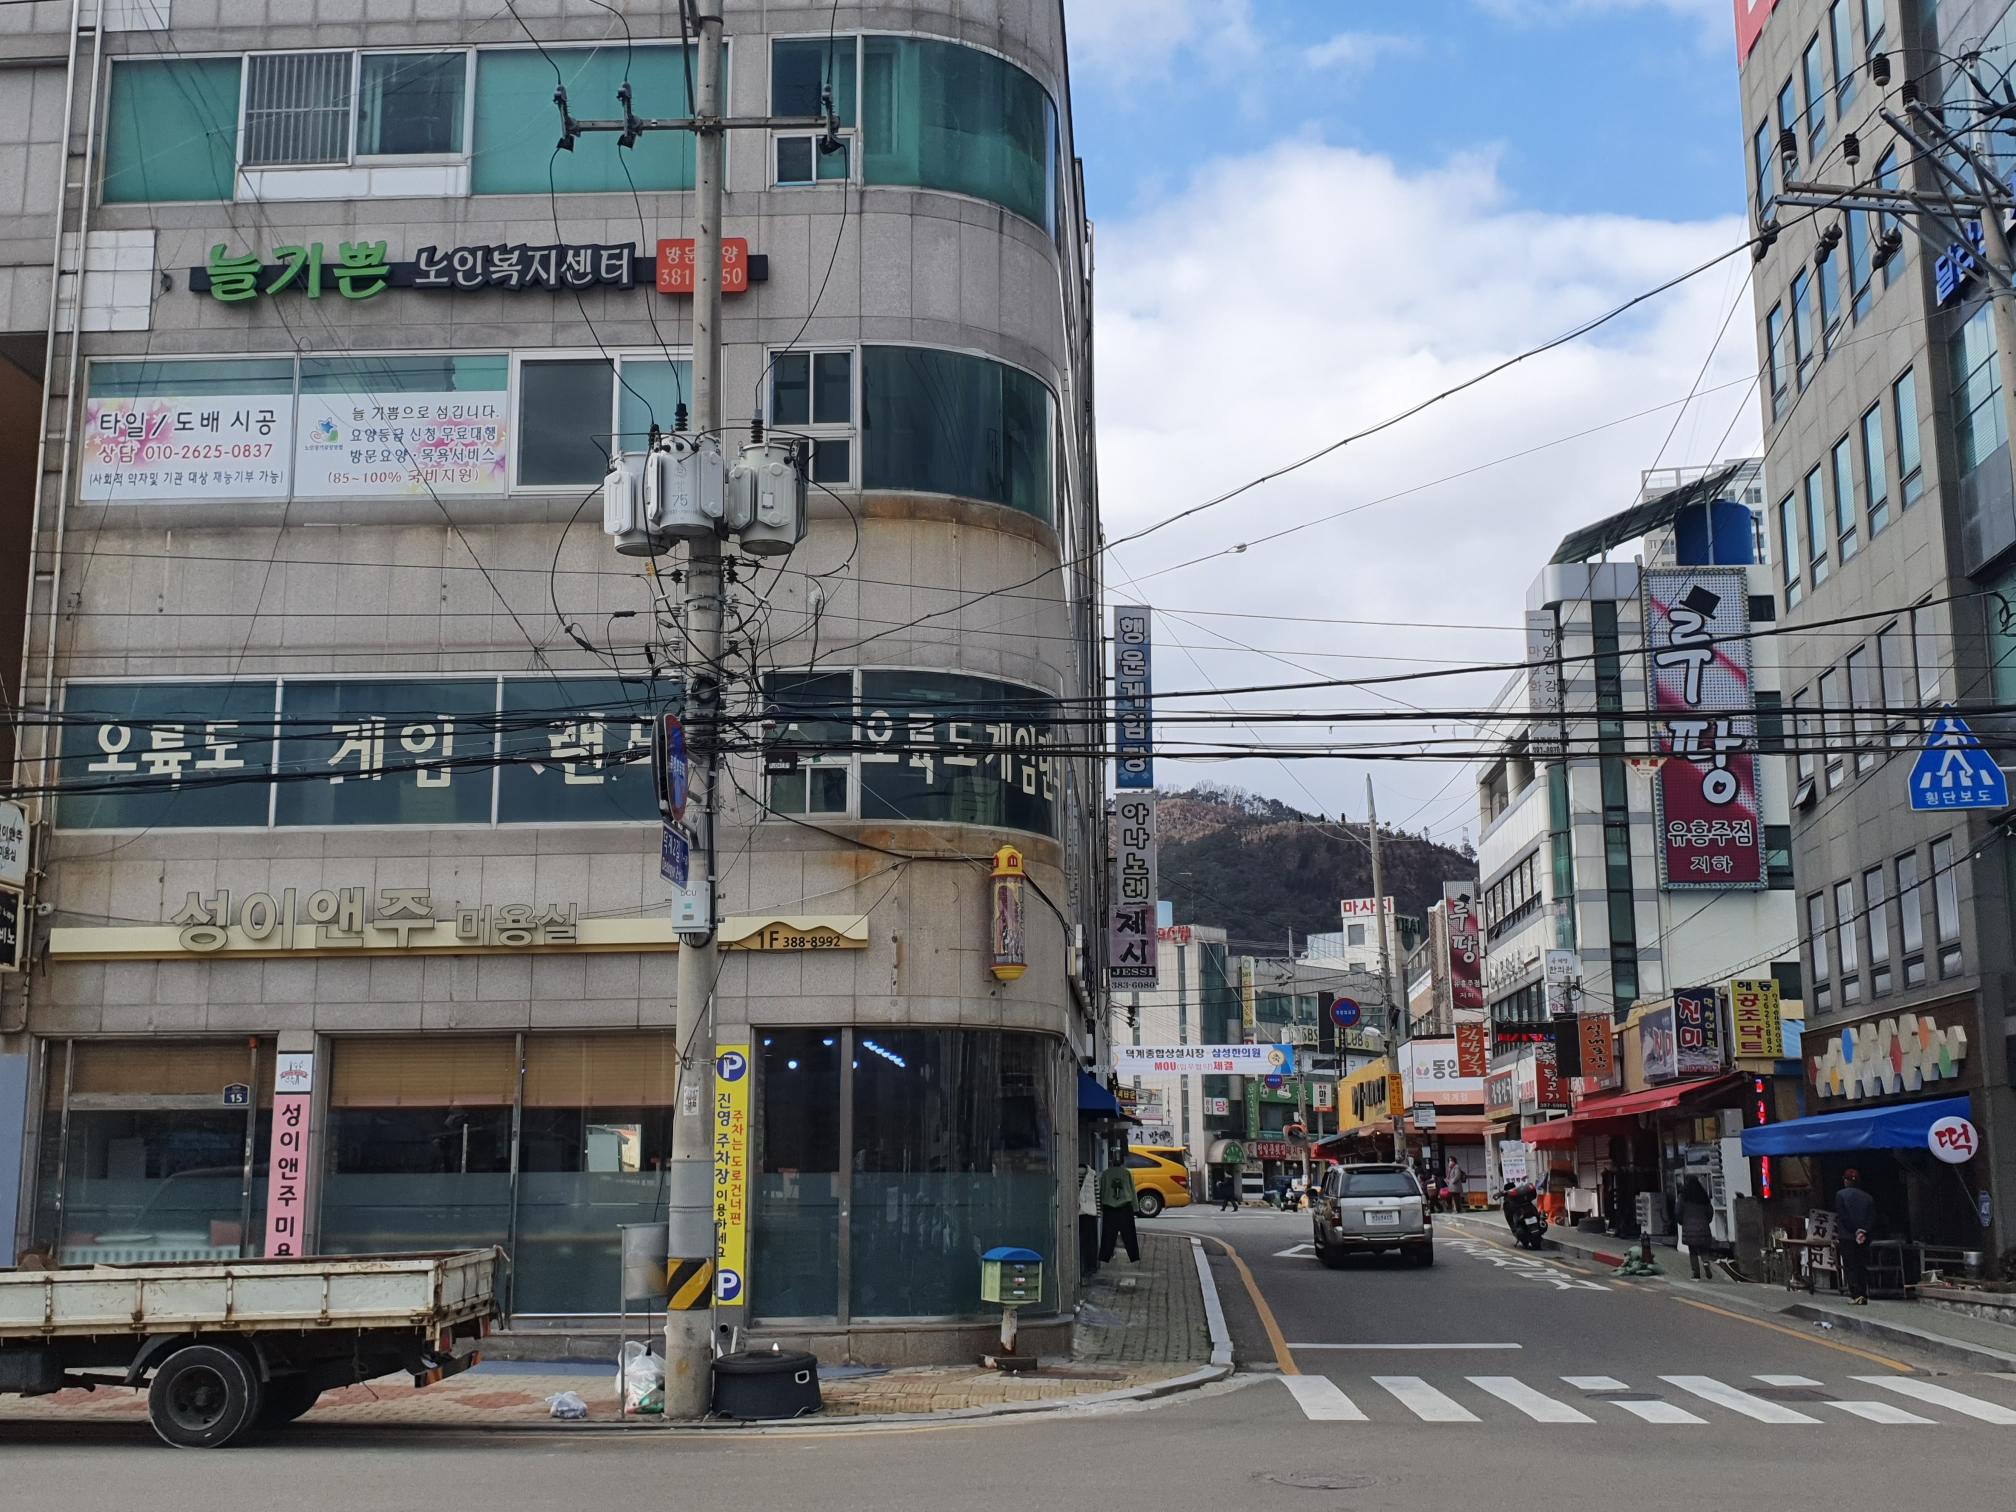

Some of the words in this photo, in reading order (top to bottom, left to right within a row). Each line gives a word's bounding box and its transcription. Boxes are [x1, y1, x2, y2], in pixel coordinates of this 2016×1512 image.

[207, 240, 391, 301] 늘기쁜
[414, 246, 631, 286] 노인복지센터
[230, 409, 276, 436] 시공
[352, 407, 366, 421] 늘
[372, 406, 430, 421] 기쁨으로
[436, 405, 500, 419] 섬깁니다.
[350, 428, 404, 443] 요양등급
[410, 427, 436, 441] 신청
[442, 426, 497, 441] 무료대행
[98, 445, 136, 464] 상담
[145, 443, 273, 460] 010-2625-0837
[89, 473, 123, 487] (사회적
[127, 473, 159, 486] 약자및
[164, 472, 184, 486] 기관
[188, 472, 209, 485] 대상
[213, 471, 255, 485] 재능기부
[258, 470, 284, 485] 가능)
[408, 468, 480, 484] 국비지원)
[1925, 790, 1992, 804] 횡단보도
[1668, 820, 1753, 847] 유흥주점
[1121, 803, 1150, 906] 아나노래
[1690, 855, 1733, 873] 지하
[171, 886, 435, 952] 성이앤주
[456, 902, 577, 947] 미용실
[758, 931, 779, 949] 1F
[783, 936, 841, 948] 388-8992
[1115, 909, 1150, 964] 제시
[1112, 967, 1154, 977] JESSI
[1111, 981, 1156, 990] 383-6080
[1678, 996, 1703, 1048] 진미
[1125, 1049, 1204, 1059] 덕계종합상설시장
[1212, 1047, 1261, 1058] 삼성한의원
[230, 1093, 243, 1103] 15
[717, 1093, 731, 1127] 진영
[1934, 1123, 1972, 1155] 떡
[278, 1103, 302, 1207] 성이앤주
[714, 1133, 730, 1185] 주차장
[715, 1189, 727, 1258] 이용하세요
